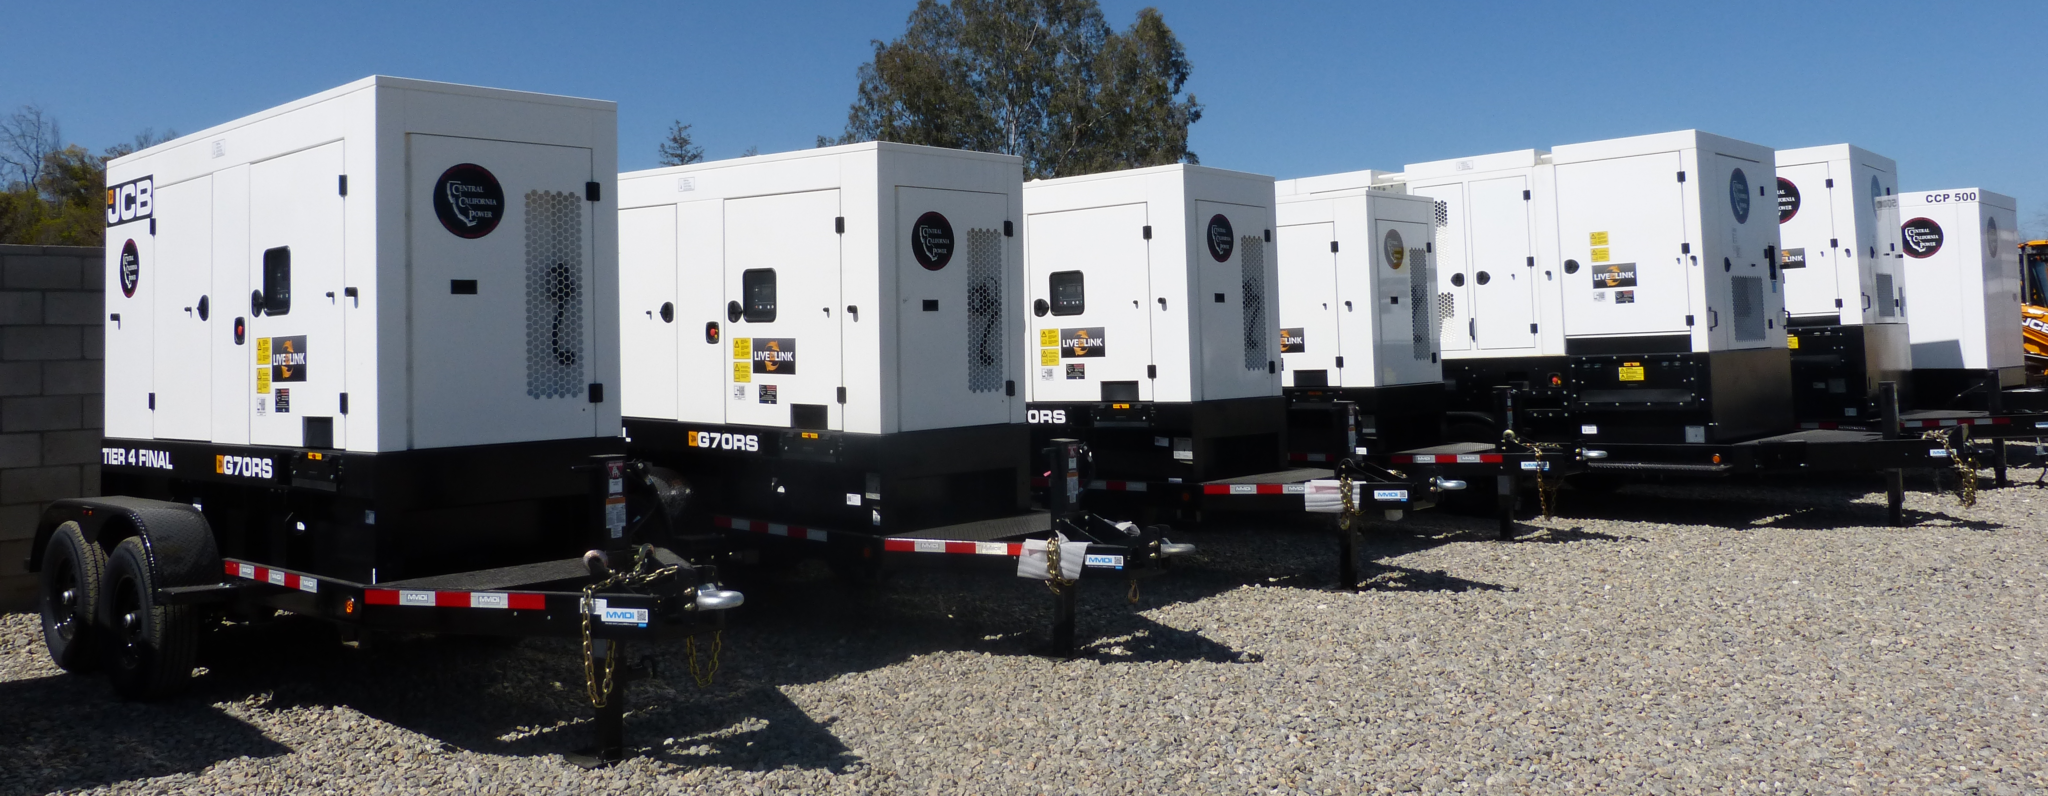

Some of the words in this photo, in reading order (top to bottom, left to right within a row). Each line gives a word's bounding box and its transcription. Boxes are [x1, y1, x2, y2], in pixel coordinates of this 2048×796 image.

[452, 184, 485, 195] CENTRAL
[107, 178, 153, 224] JCB
[458, 196, 497, 208] CALIFORNIA
[1925, 193, 1951, 204] CCP
[1954, 191, 1977, 202] 500
[468, 210, 493, 221] POWER
[1785, 254, 1804, 262] LINK
[1593, 272, 1611, 281] LIVE
[1615, 271, 1635, 280] LINK
[1062, 339, 1079, 348] LIVE
[1083, 337, 1103, 347] LINK
[1285, 336, 1303, 345] LINK
[272, 353, 286, 366] LIVE
[290, 352, 306, 365] LINK
[754, 350, 770, 361] LIVE
[774, 351, 794, 362] LINK
[1025, 409, 1066, 424] ORS
[697, 431, 759, 452] G70RS
[102, 447, 126, 466] TIER
[128, 448, 137, 465] 4
[138, 449, 174, 471] FINAL
[223, 455, 273, 479] G70RS
[605, 610, 635, 619] MMDi
